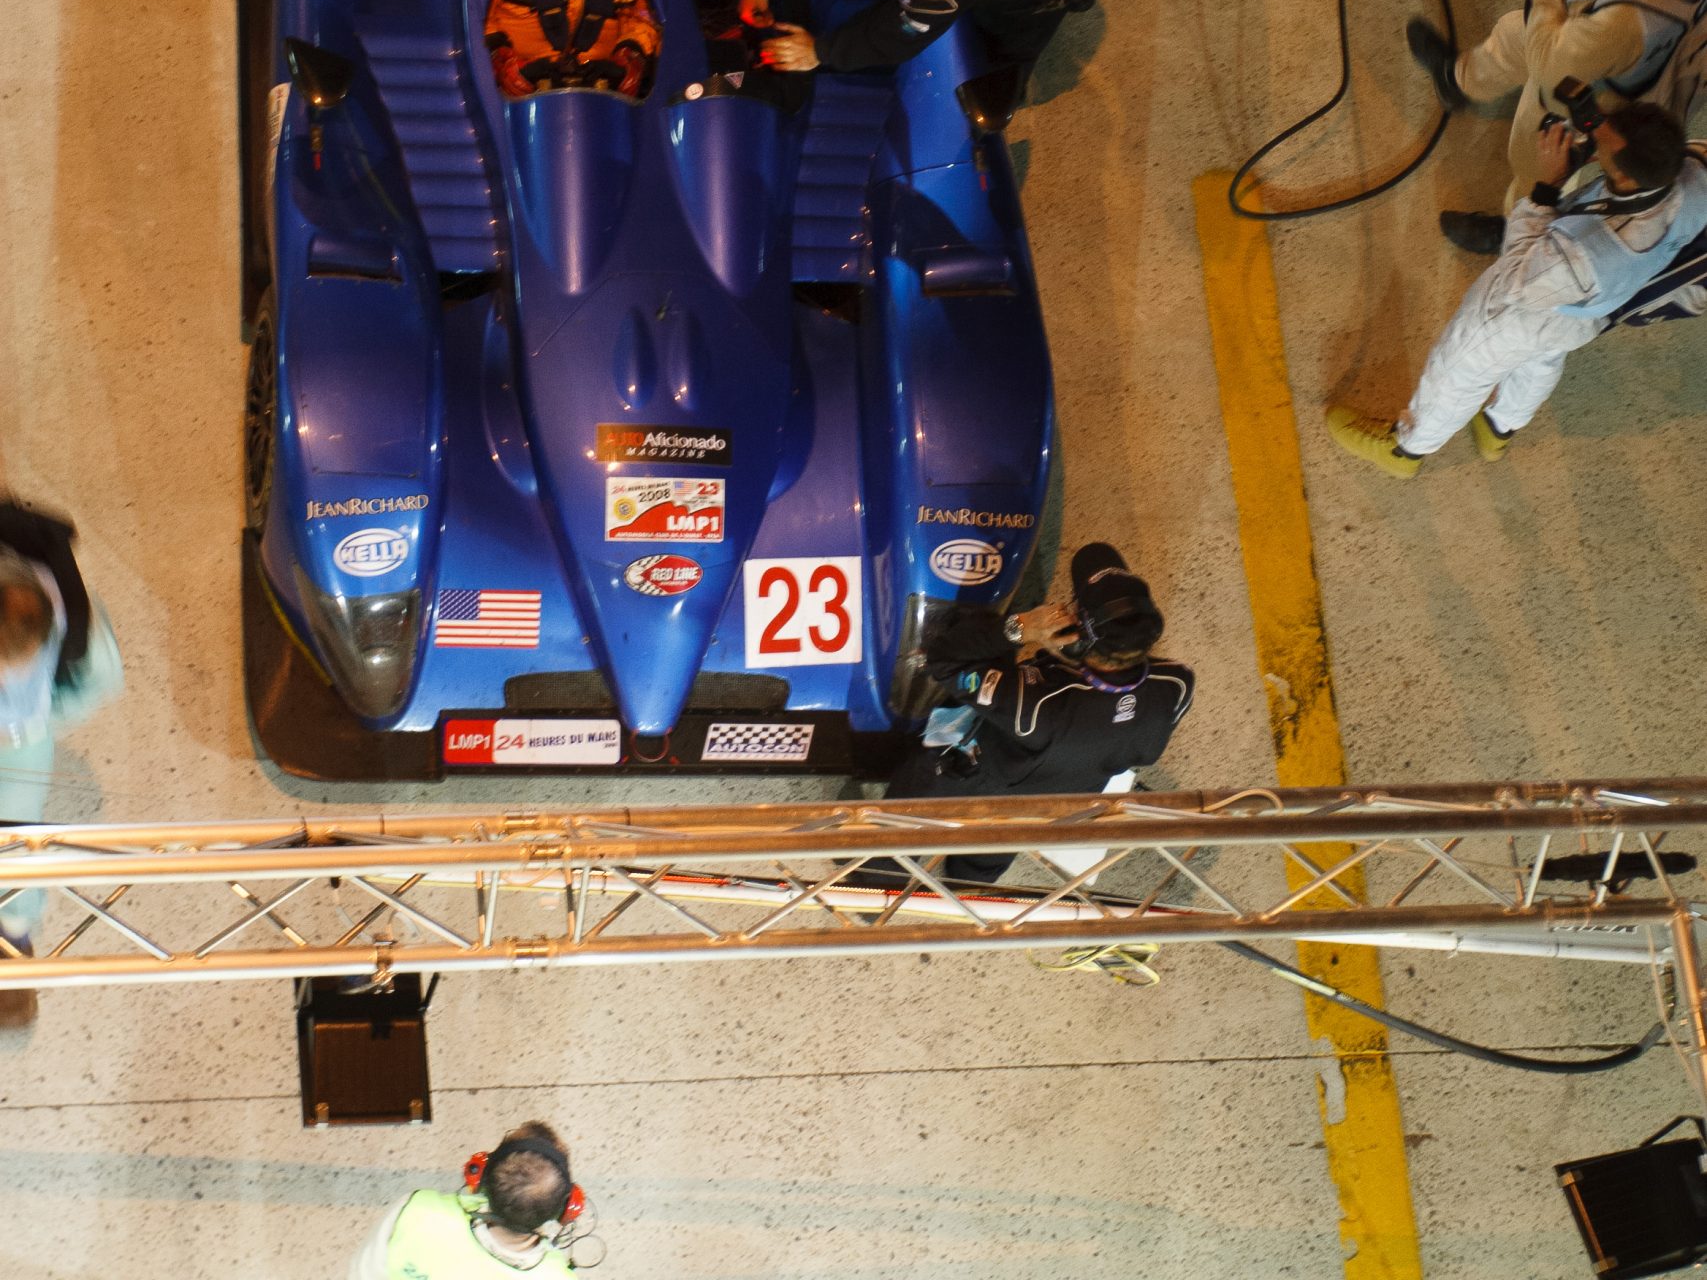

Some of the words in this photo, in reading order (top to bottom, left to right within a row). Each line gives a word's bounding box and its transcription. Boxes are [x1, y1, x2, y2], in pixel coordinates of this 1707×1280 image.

[625, 446, 705, 458] MAGAZINE
[638, 488, 671, 503] 2008
[696, 482, 719, 495] 23
[666, 515, 719, 531] LMP1
[340, 540, 409, 562] HELLA
[937, 553, 1003, 574] HELLA
[650, 568, 673, 581] RED
[758, 564, 851, 654] 23
[449, 734, 491, 750] LMP1
[496, 734, 524, 751] 24
[529, 736, 566, 748] HEURES
[570, 733, 583, 743] DU
[709, 743, 805, 753] AUTOCON
